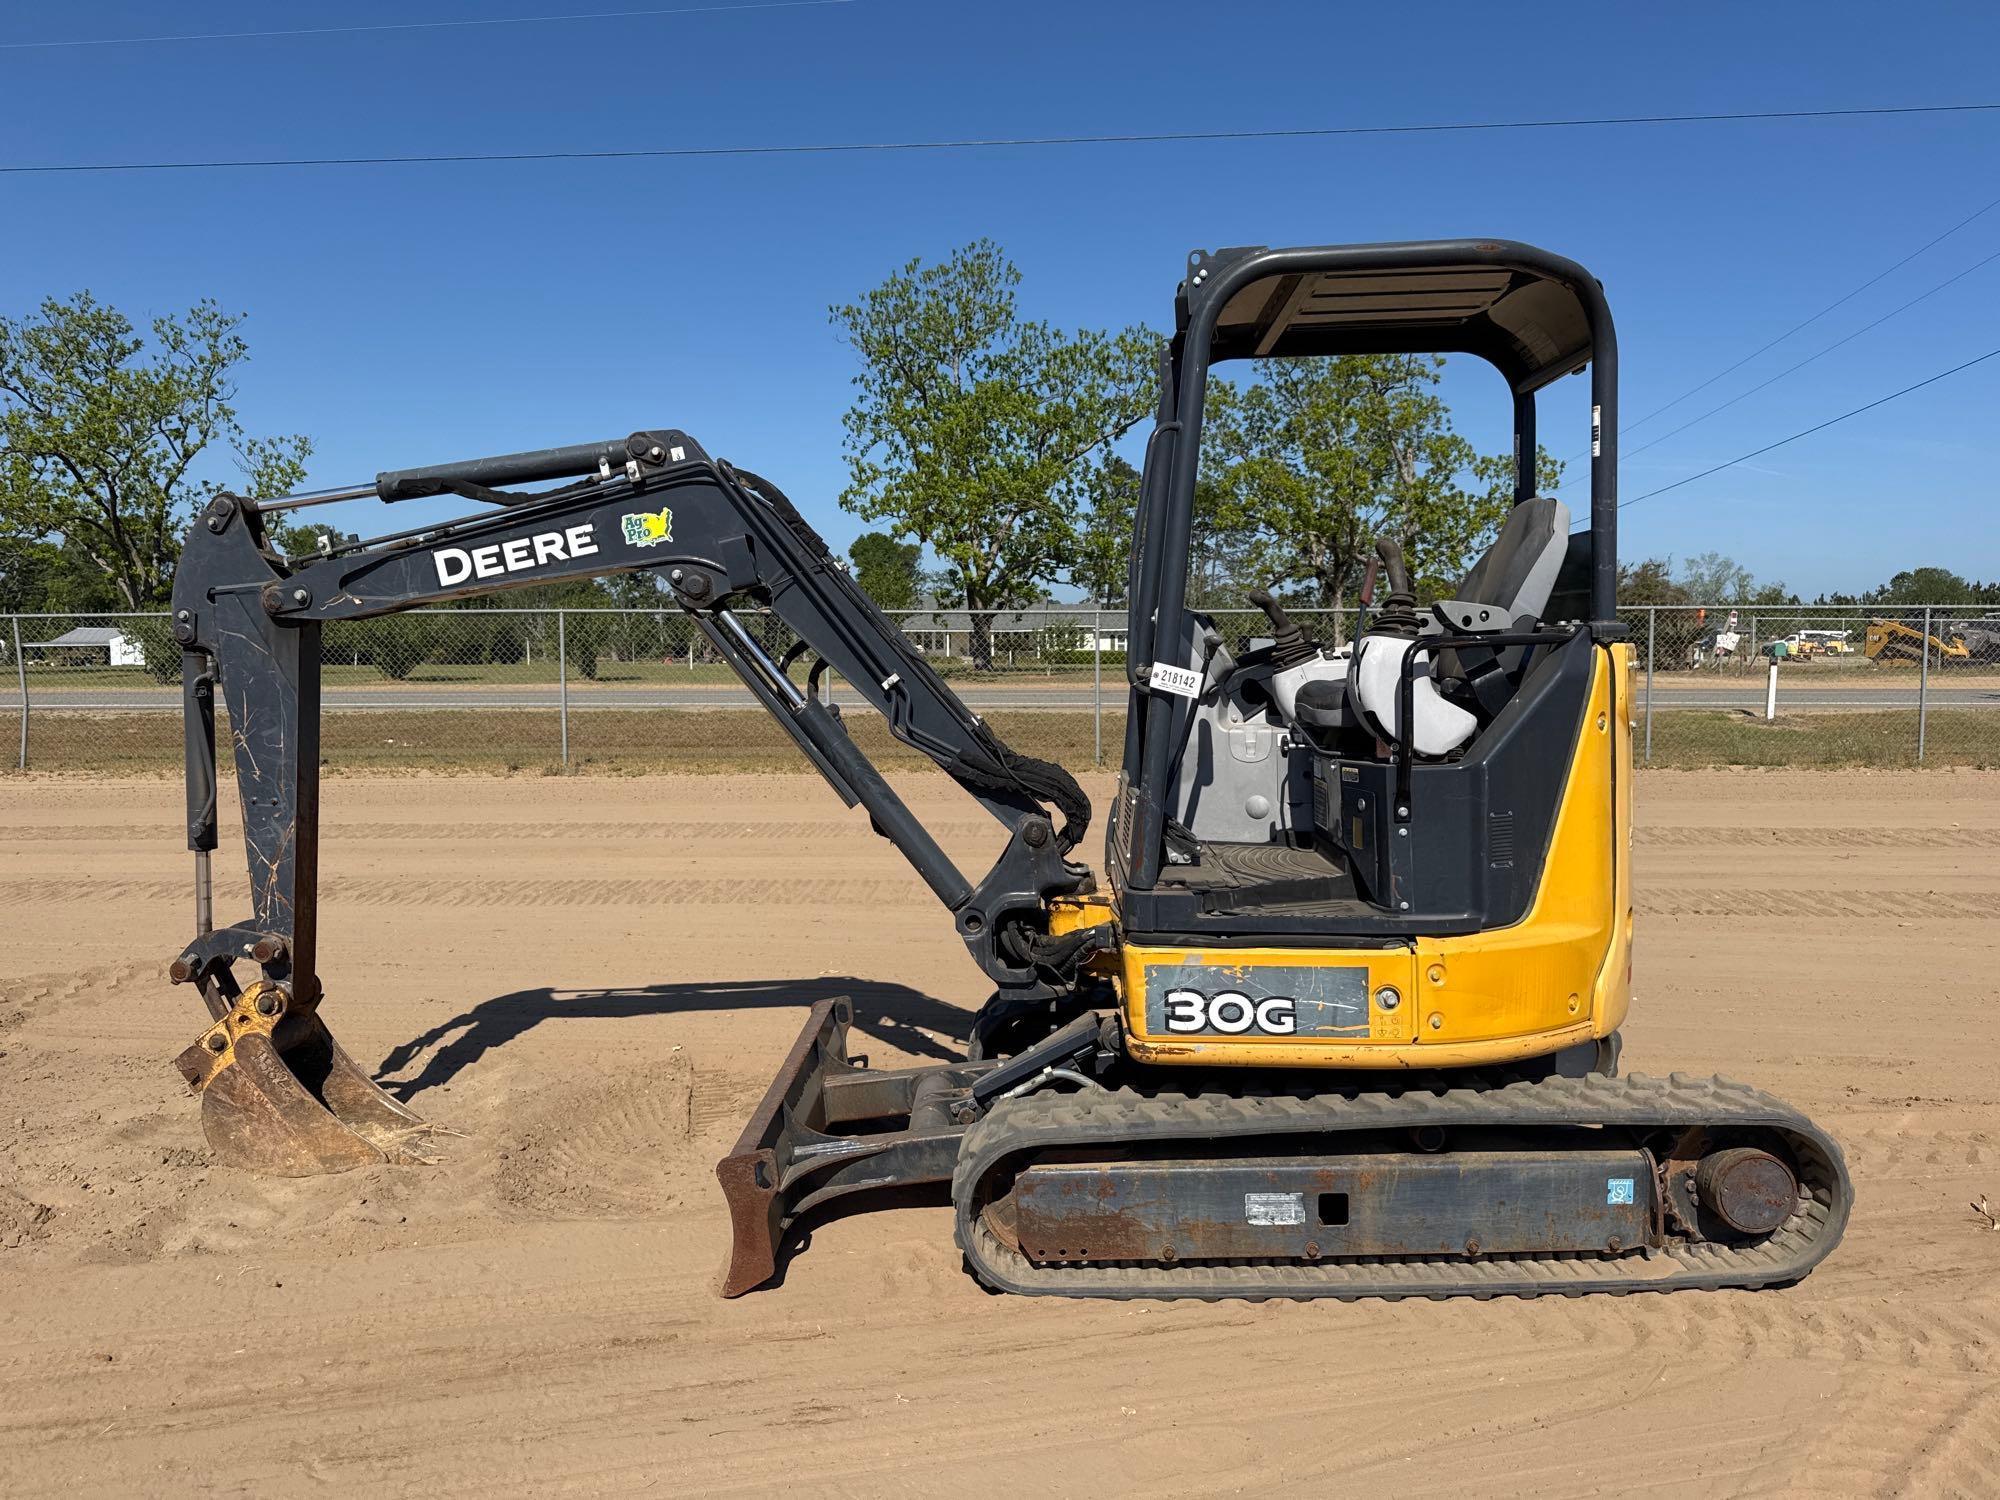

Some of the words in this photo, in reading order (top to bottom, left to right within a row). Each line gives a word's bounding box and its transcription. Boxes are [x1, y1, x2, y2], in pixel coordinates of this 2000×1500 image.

[627, 528, 651, 542] Pro
[433, 523, 599, 587] DEERE
[1161, 669, 1196, 689] 218142
[1165, 989, 1297, 1035] 30G
